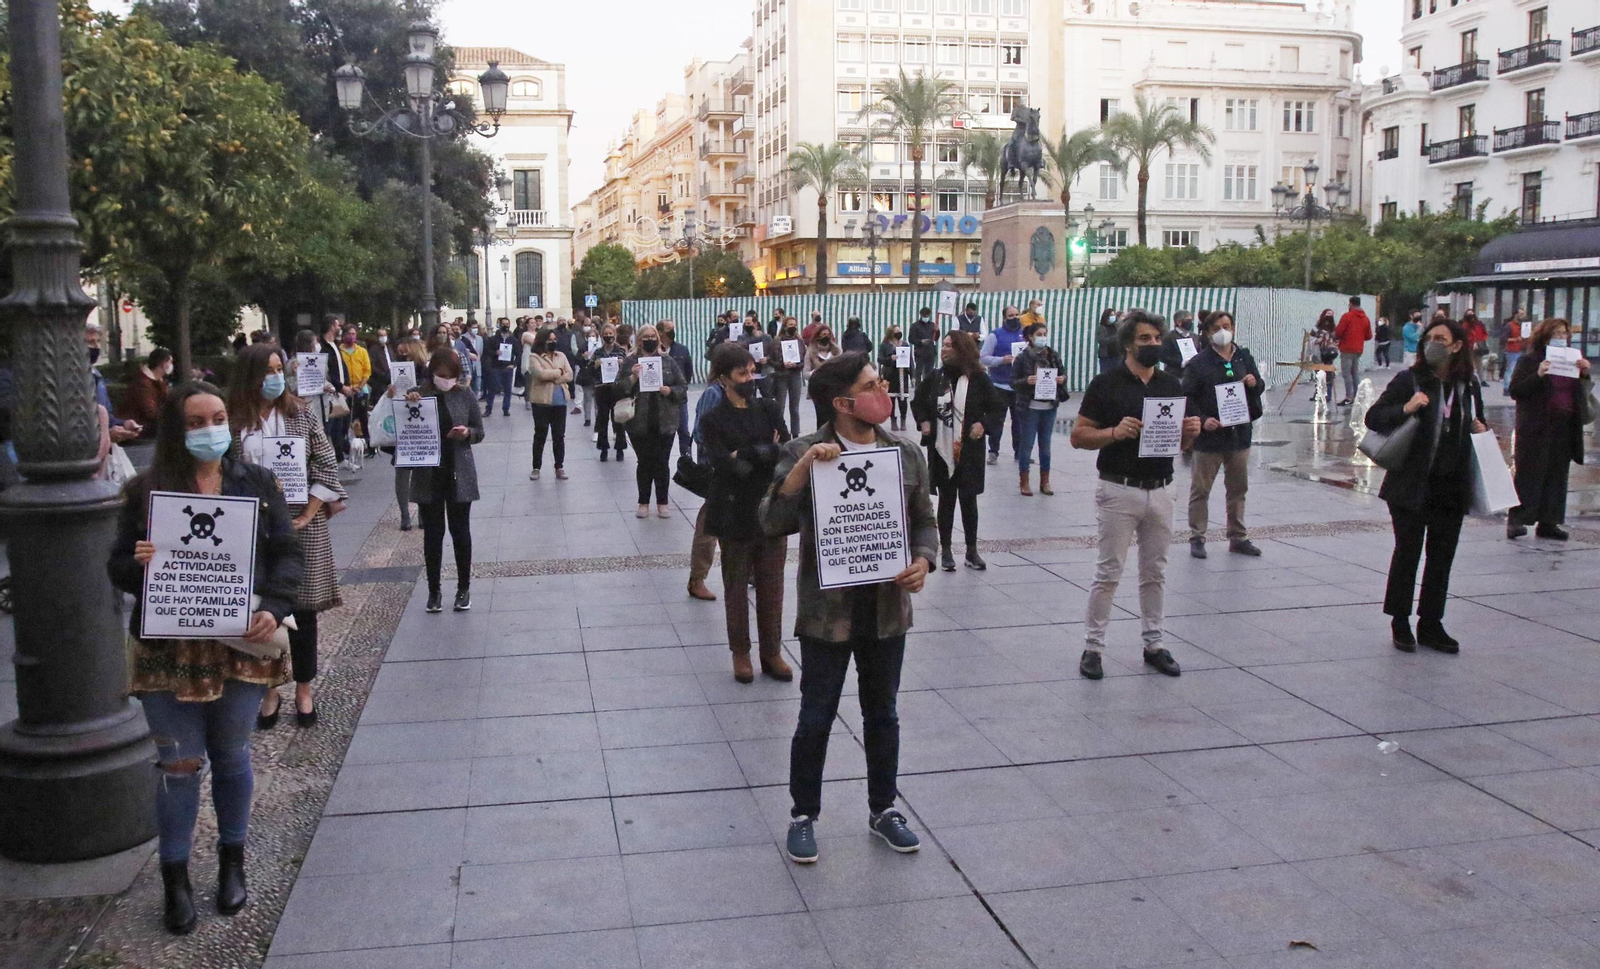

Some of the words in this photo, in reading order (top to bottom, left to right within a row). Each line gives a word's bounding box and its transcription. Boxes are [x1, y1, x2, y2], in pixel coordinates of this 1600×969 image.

[834, 503, 865, 513] TODAS
[868, 502, 884, 510] LAS
[829, 511, 890, 524] ACTIVIDADES
[823, 527, 841, 535] SON
[844, 521, 898, 533] ESENCIALES
[846, 532, 889, 544] MOMENTO
[822, 548, 840, 556] QUE
[842, 546, 858, 554] HAY
[860, 541, 902, 552] FAMILIAS
[170, 550, 208, 560] TODAS
[829, 558, 846, 566] QUE
[848, 553, 882, 564] COMEN
[885, 552, 897, 560] DE
[162, 561, 236, 572] ACTIVIDADES
[849, 564, 878, 574] ELLAS
[154, 573, 176, 581] SON
[179, 573, 243, 583] ESENCIALES
[149, 584, 162, 592] EN
[166, 584, 177, 592] EL
[180, 585, 231, 594] MOMENTO
[149, 595, 170, 604] QUE
[196, 597, 245, 606] FAMILIAS
[155, 607, 176, 615] QUE
[180, 607, 220, 616] COMEN
[223, 608, 238, 617] DE
[178, 619, 214, 627] ELLAS
